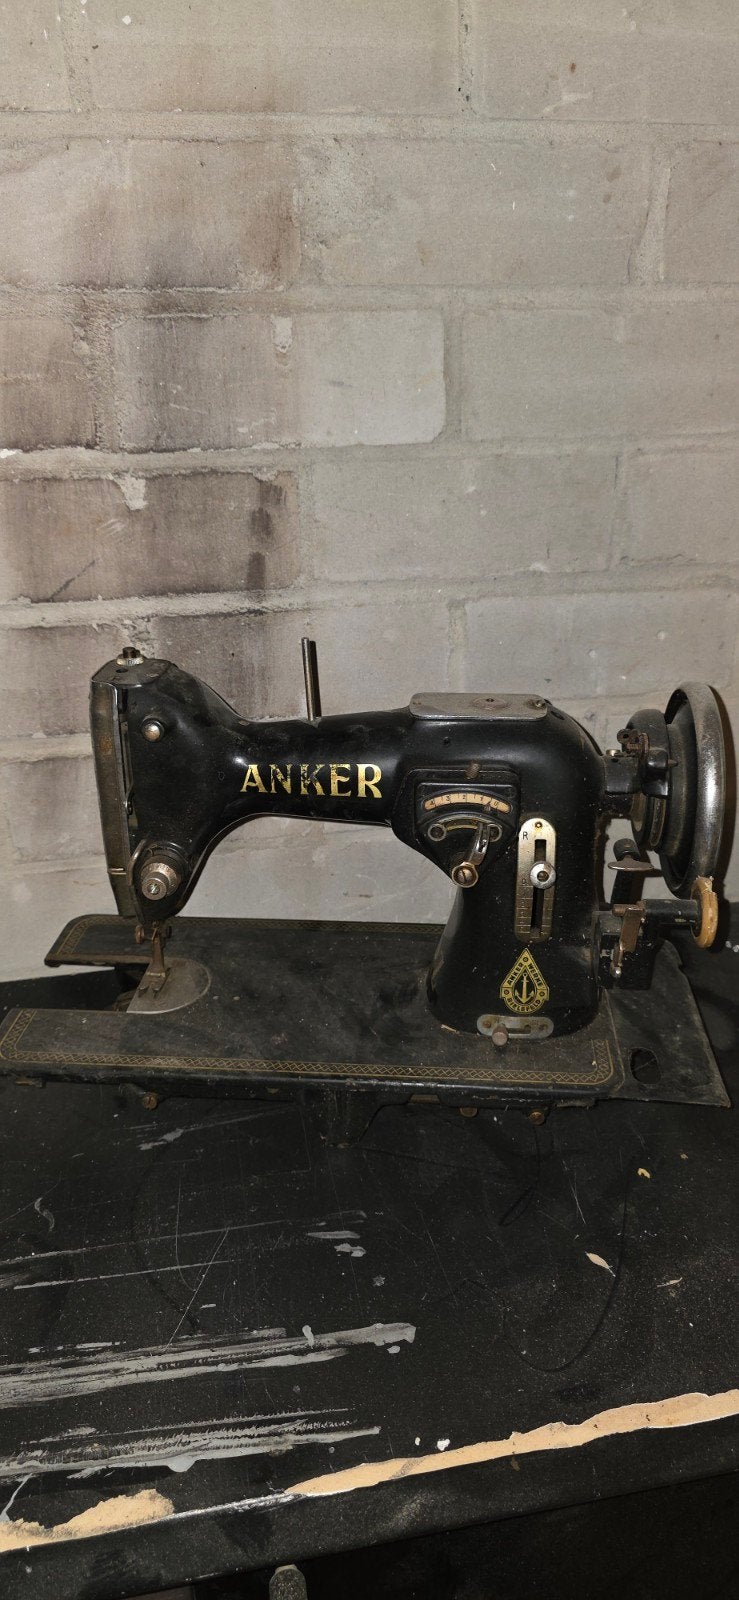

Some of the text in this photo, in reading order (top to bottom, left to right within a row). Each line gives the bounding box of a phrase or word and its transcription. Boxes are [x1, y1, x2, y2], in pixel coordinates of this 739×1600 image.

[240, 763, 382, 798] ANKER
[522, 831, 528, 840] R
[507, 962, 524, 985] ANKER
